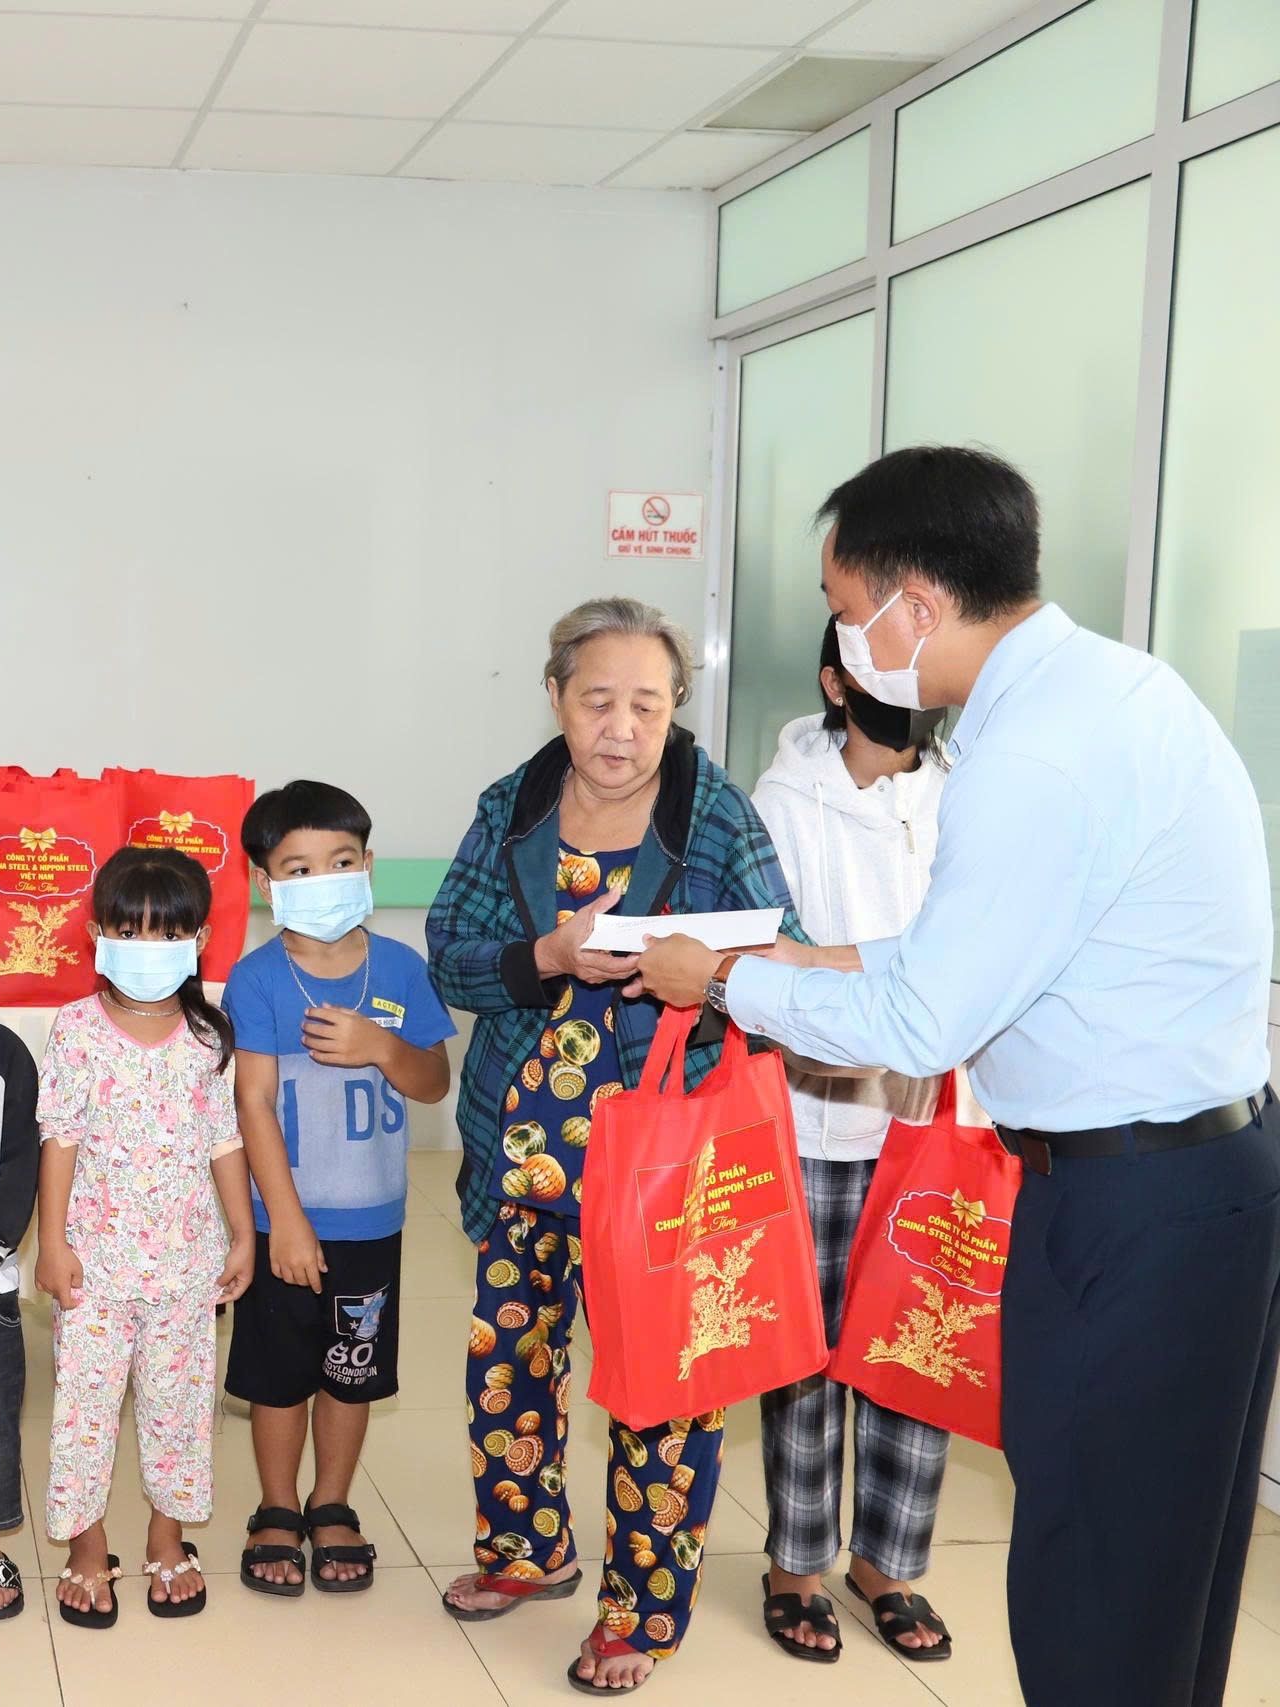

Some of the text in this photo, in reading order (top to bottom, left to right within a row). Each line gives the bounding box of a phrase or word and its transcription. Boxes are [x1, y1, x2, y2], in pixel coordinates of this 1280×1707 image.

[612, 525, 697, 544] CẤM HÚT THUỐC
[6, 853, 25, 862] CÔNG
[20, 873, 36, 881] VIỆT
[39, 864, 66, 872] NIPPON
[707, 1181, 745, 1201] NIPPON
[746, 1171, 776, 1189] STEEL
[708, 1200, 731, 1215] NAM
[927, 1215, 952, 1231] CÔNG
[952, 1224, 961, 1236] TY
[896, 1218, 926, 1234] CHINA
[928, 1227, 953, 1245] STEEL
[960, 1242, 990, 1263] NIPPON
[940, 1244, 972, 1269] VIỆT NAM
